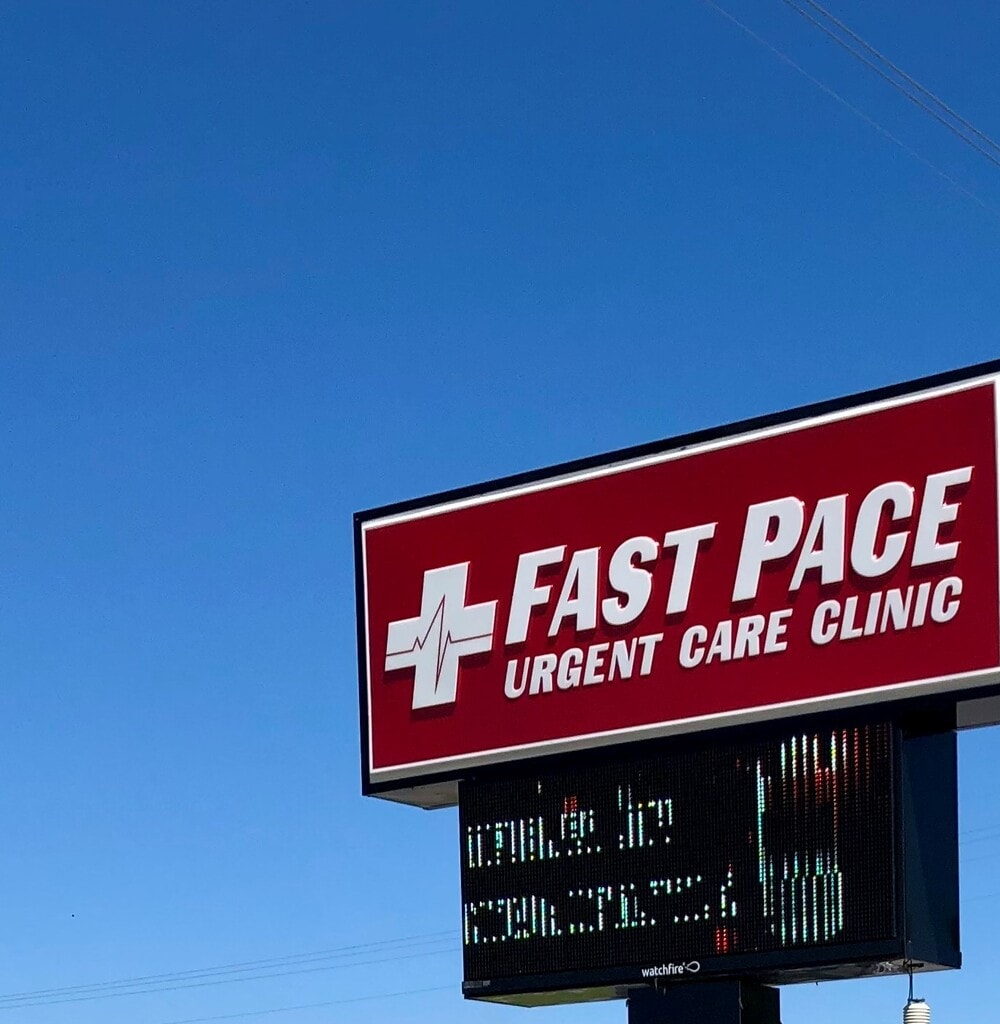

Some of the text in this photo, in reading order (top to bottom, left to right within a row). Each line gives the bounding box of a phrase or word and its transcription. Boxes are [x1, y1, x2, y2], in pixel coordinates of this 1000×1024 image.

[504, 465, 975, 645] FAST PACE
[503, 576, 964, 700] URGENT CARE CLINIC
[641, 963, 684, 977] watchfire
